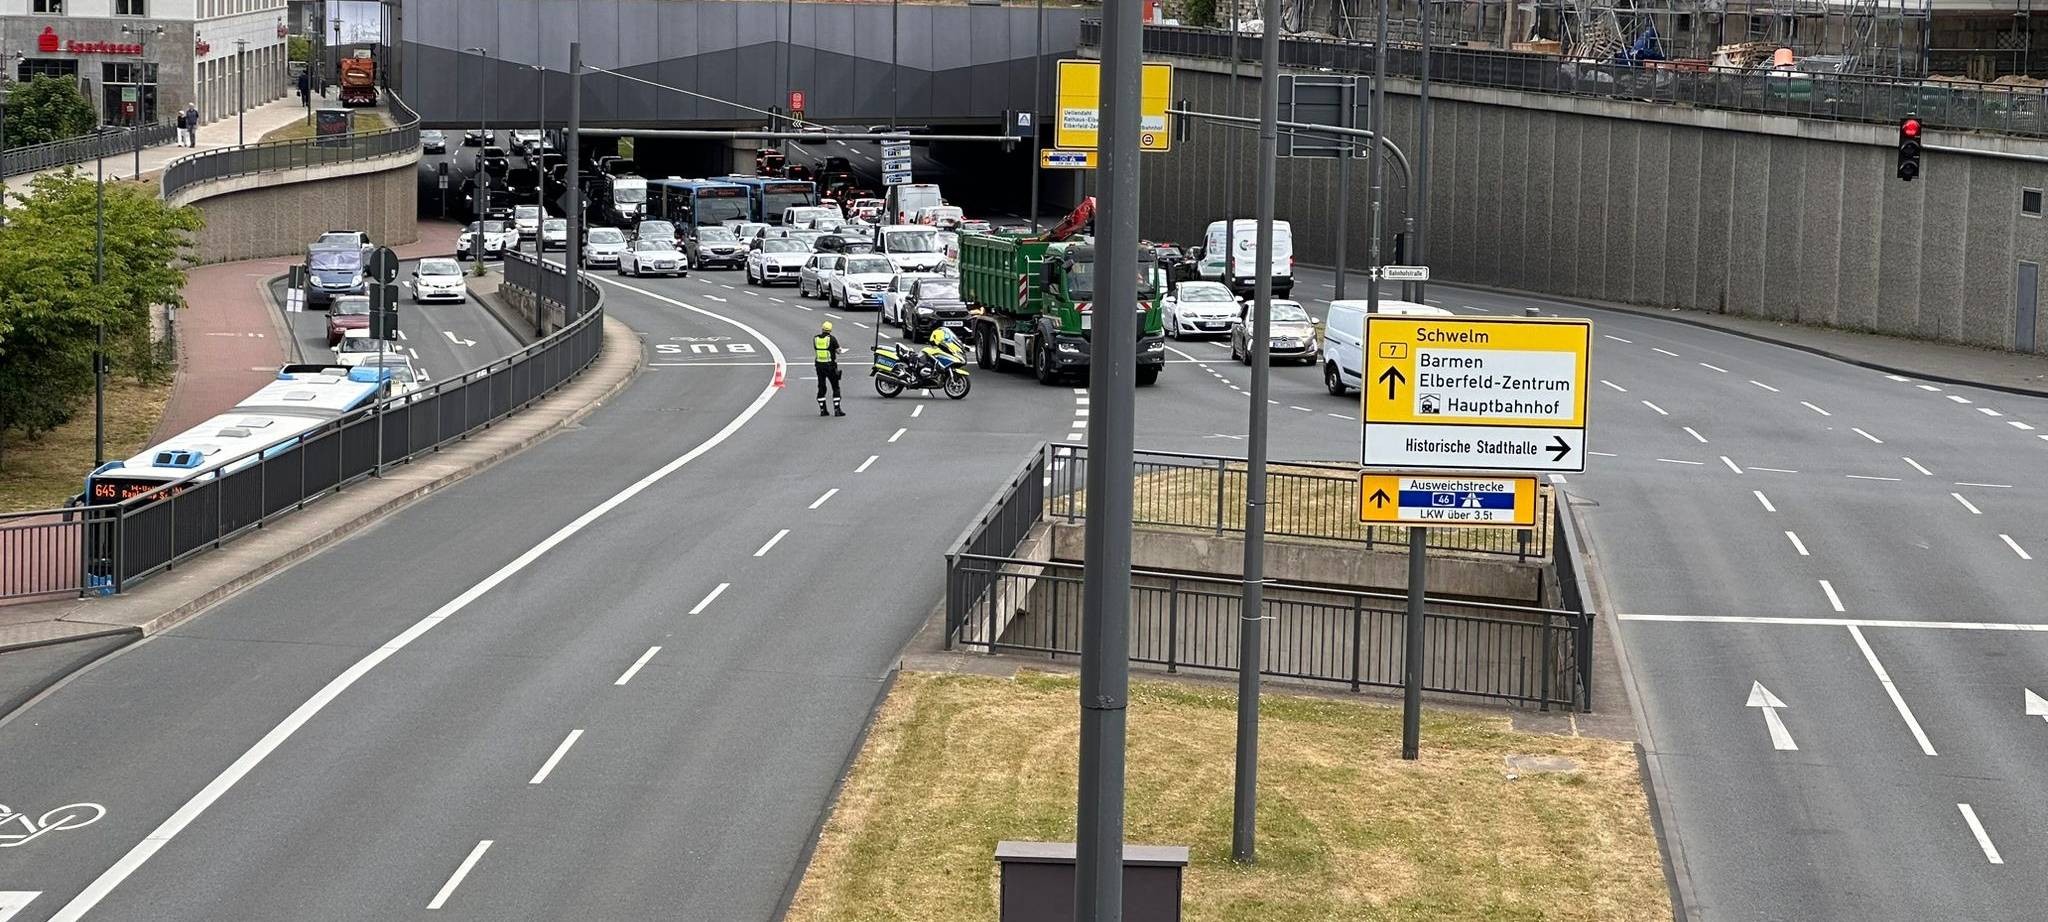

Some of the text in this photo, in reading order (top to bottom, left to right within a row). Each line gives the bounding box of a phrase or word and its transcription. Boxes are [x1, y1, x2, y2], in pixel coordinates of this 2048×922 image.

[66, 39, 144, 55] Sparkasse
[1416, 327, 1489, 343] Schwelm
[655, 343, 756, 354] BUS
[1390, 345, 1397, 356] 7
[1420, 353, 1484, 369] Barmen
[1419, 373, 1570, 391] Elberfeld-Zentrum
[1448, 398, 1560, 415] Hauptbahnhof
[1405, 438, 1538, 455] Historische Stadthalle
[95, 484, 116, 498] 645
[1410, 479, 1504, 492] Ausweichstrecke
[1438, 495, 1450, 504] 46
[1420, 509, 1444, 519] LKW
[1447, 510, 1470, 520] über
